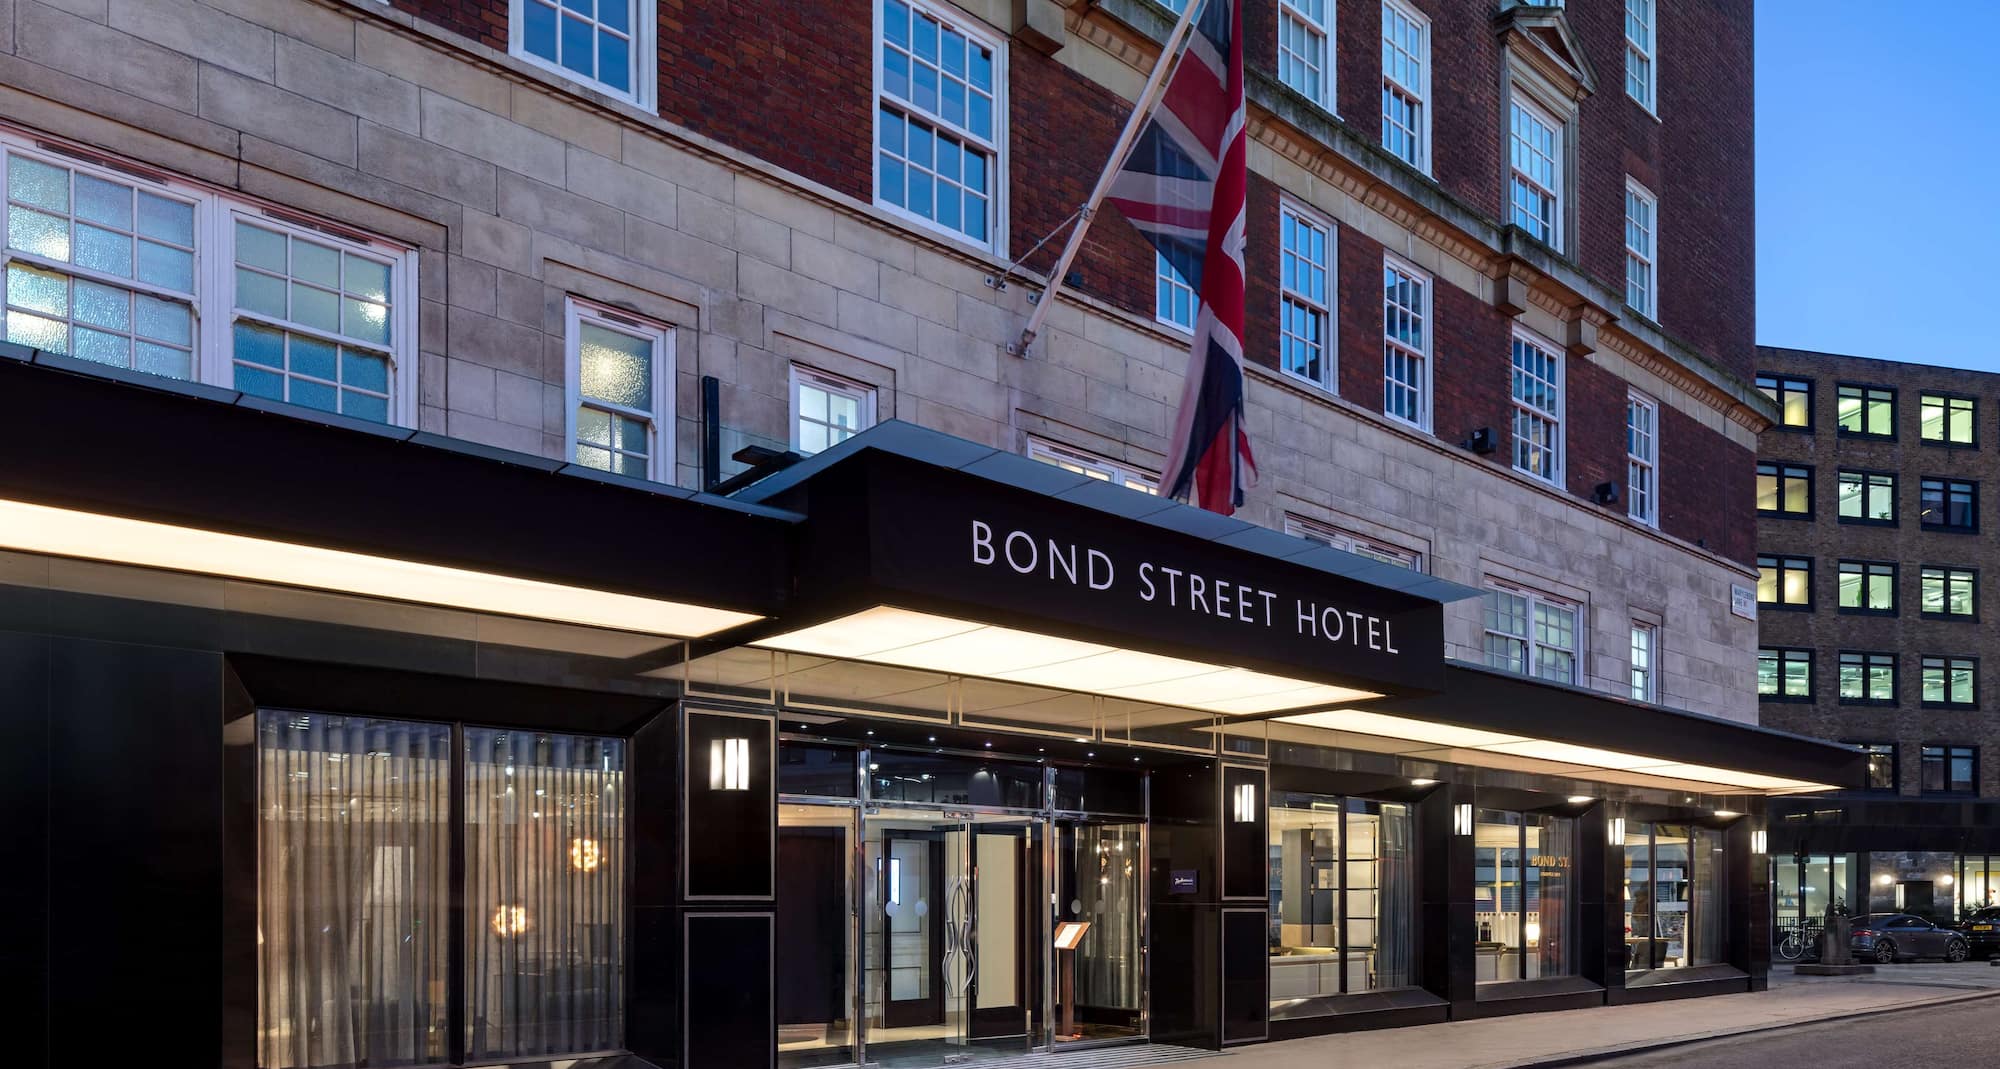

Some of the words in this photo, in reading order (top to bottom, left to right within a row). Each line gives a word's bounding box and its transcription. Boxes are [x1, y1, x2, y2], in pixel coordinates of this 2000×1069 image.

[972, 520, 1114, 591] BOND
[1139, 562, 1277, 627] STREET
[1297, 599, 1399, 654] HOTEL
[1531, 855, 1556, 867] BOND
